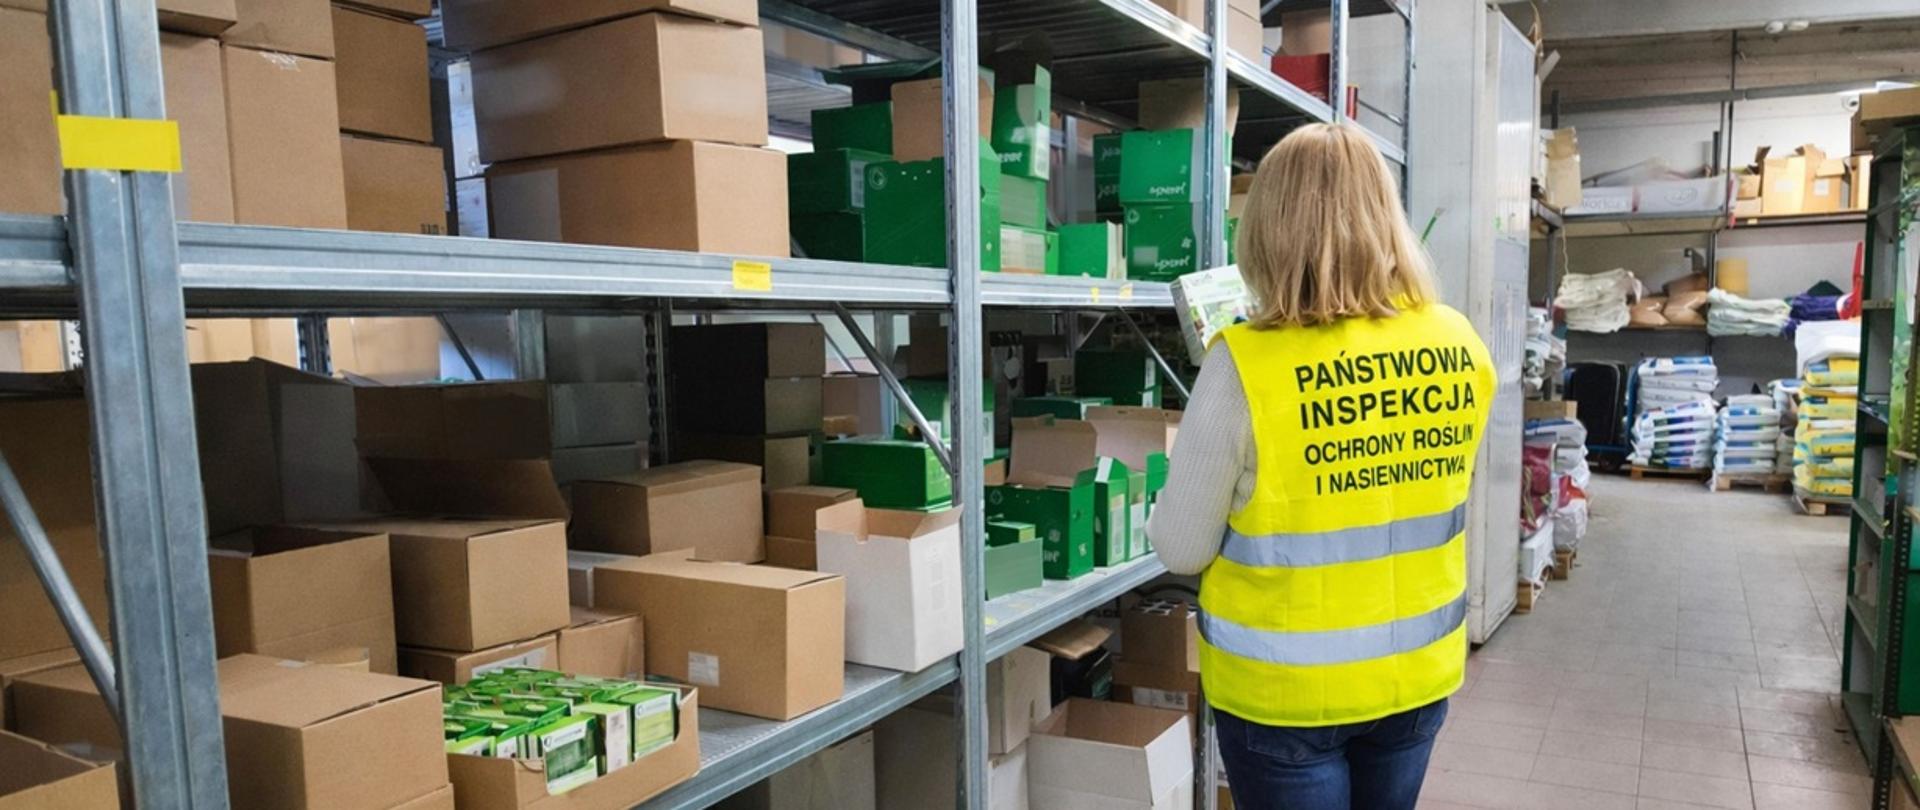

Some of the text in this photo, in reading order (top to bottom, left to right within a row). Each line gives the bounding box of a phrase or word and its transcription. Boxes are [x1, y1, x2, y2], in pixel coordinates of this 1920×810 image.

[1295, 346, 1475, 393] PAŃSTWOWA
[1301, 382, 1475, 430] INSPEKCJA
[1304, 421, 1474, 466] OCHRONY ROŚLIN
[1316, 455, 1466, 495] I NASIENNICTWA
